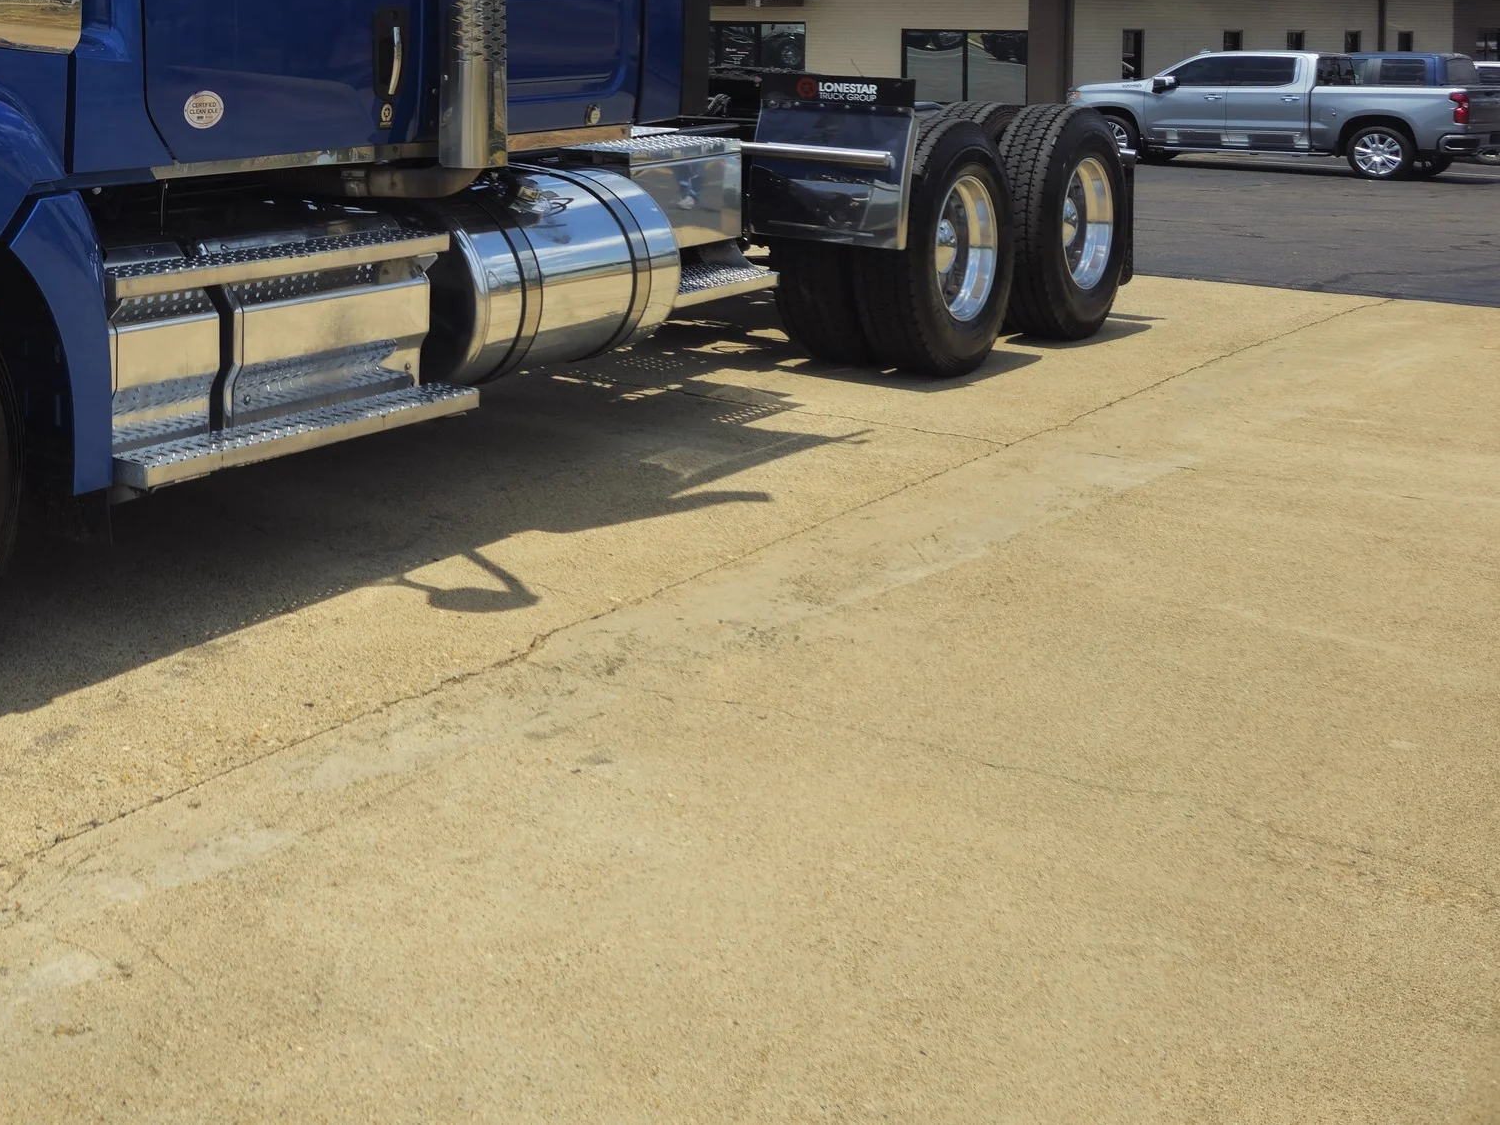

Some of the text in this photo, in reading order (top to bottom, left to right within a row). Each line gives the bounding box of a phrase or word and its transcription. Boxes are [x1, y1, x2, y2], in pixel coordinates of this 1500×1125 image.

[818, 82, 877, 94] LONESTAR
[819, 92, 877, 102] TRUCK GROUP
